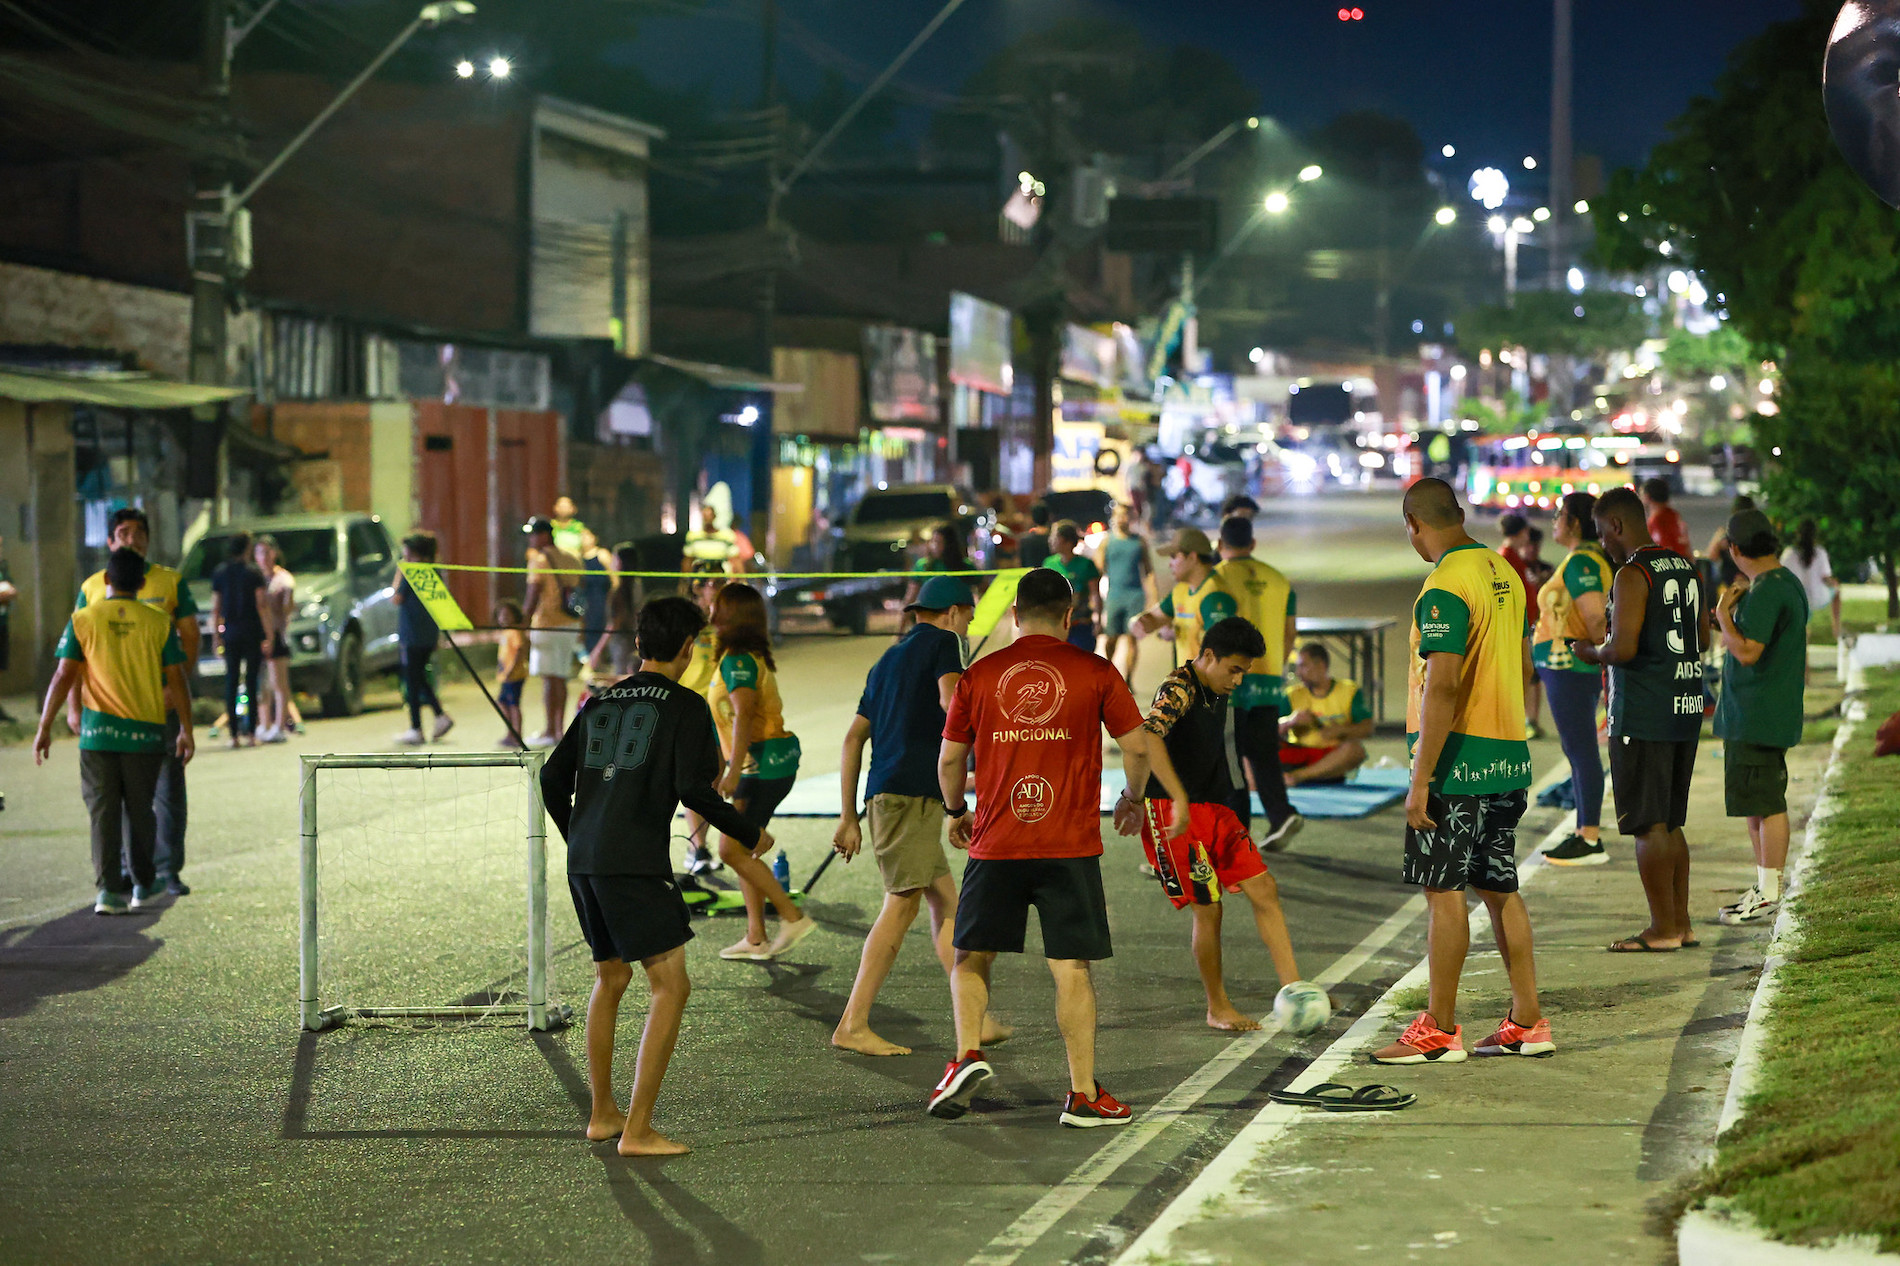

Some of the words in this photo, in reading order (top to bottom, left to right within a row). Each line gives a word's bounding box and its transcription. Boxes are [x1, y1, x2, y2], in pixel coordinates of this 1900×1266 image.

[1663, 577, 1700, 654] 31
[1673, 692, 1704, 714] FÁBIO
[583, 701, 660, 770] 88
[1016, 782, 1044, 802] ADJ
